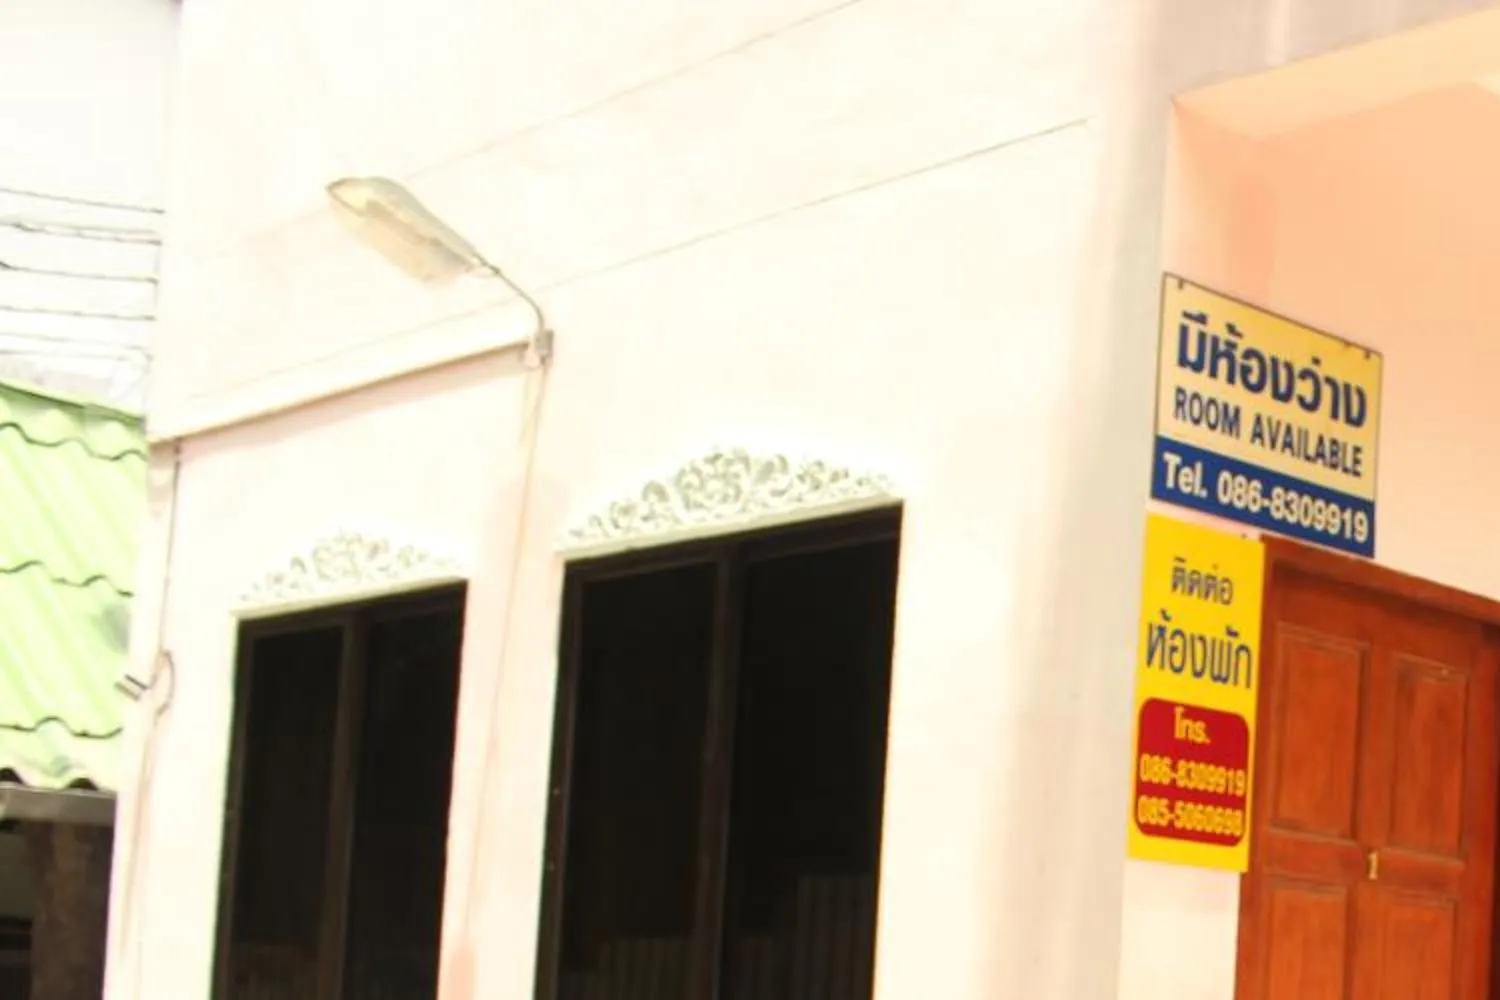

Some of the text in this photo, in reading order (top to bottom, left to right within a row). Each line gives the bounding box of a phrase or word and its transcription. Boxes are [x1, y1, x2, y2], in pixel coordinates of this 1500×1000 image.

[1177, 309, 1368, 429] มีห้องว่าง
[1173, 386, 1362, 478] ROOM AVAILABLE
[1163, 451, 1369, 543] Tel. 086-8309919
[1171, 555, 1233, 606] ติดต่อ
[1146, 608, 1252, 690] ห้องพัก
